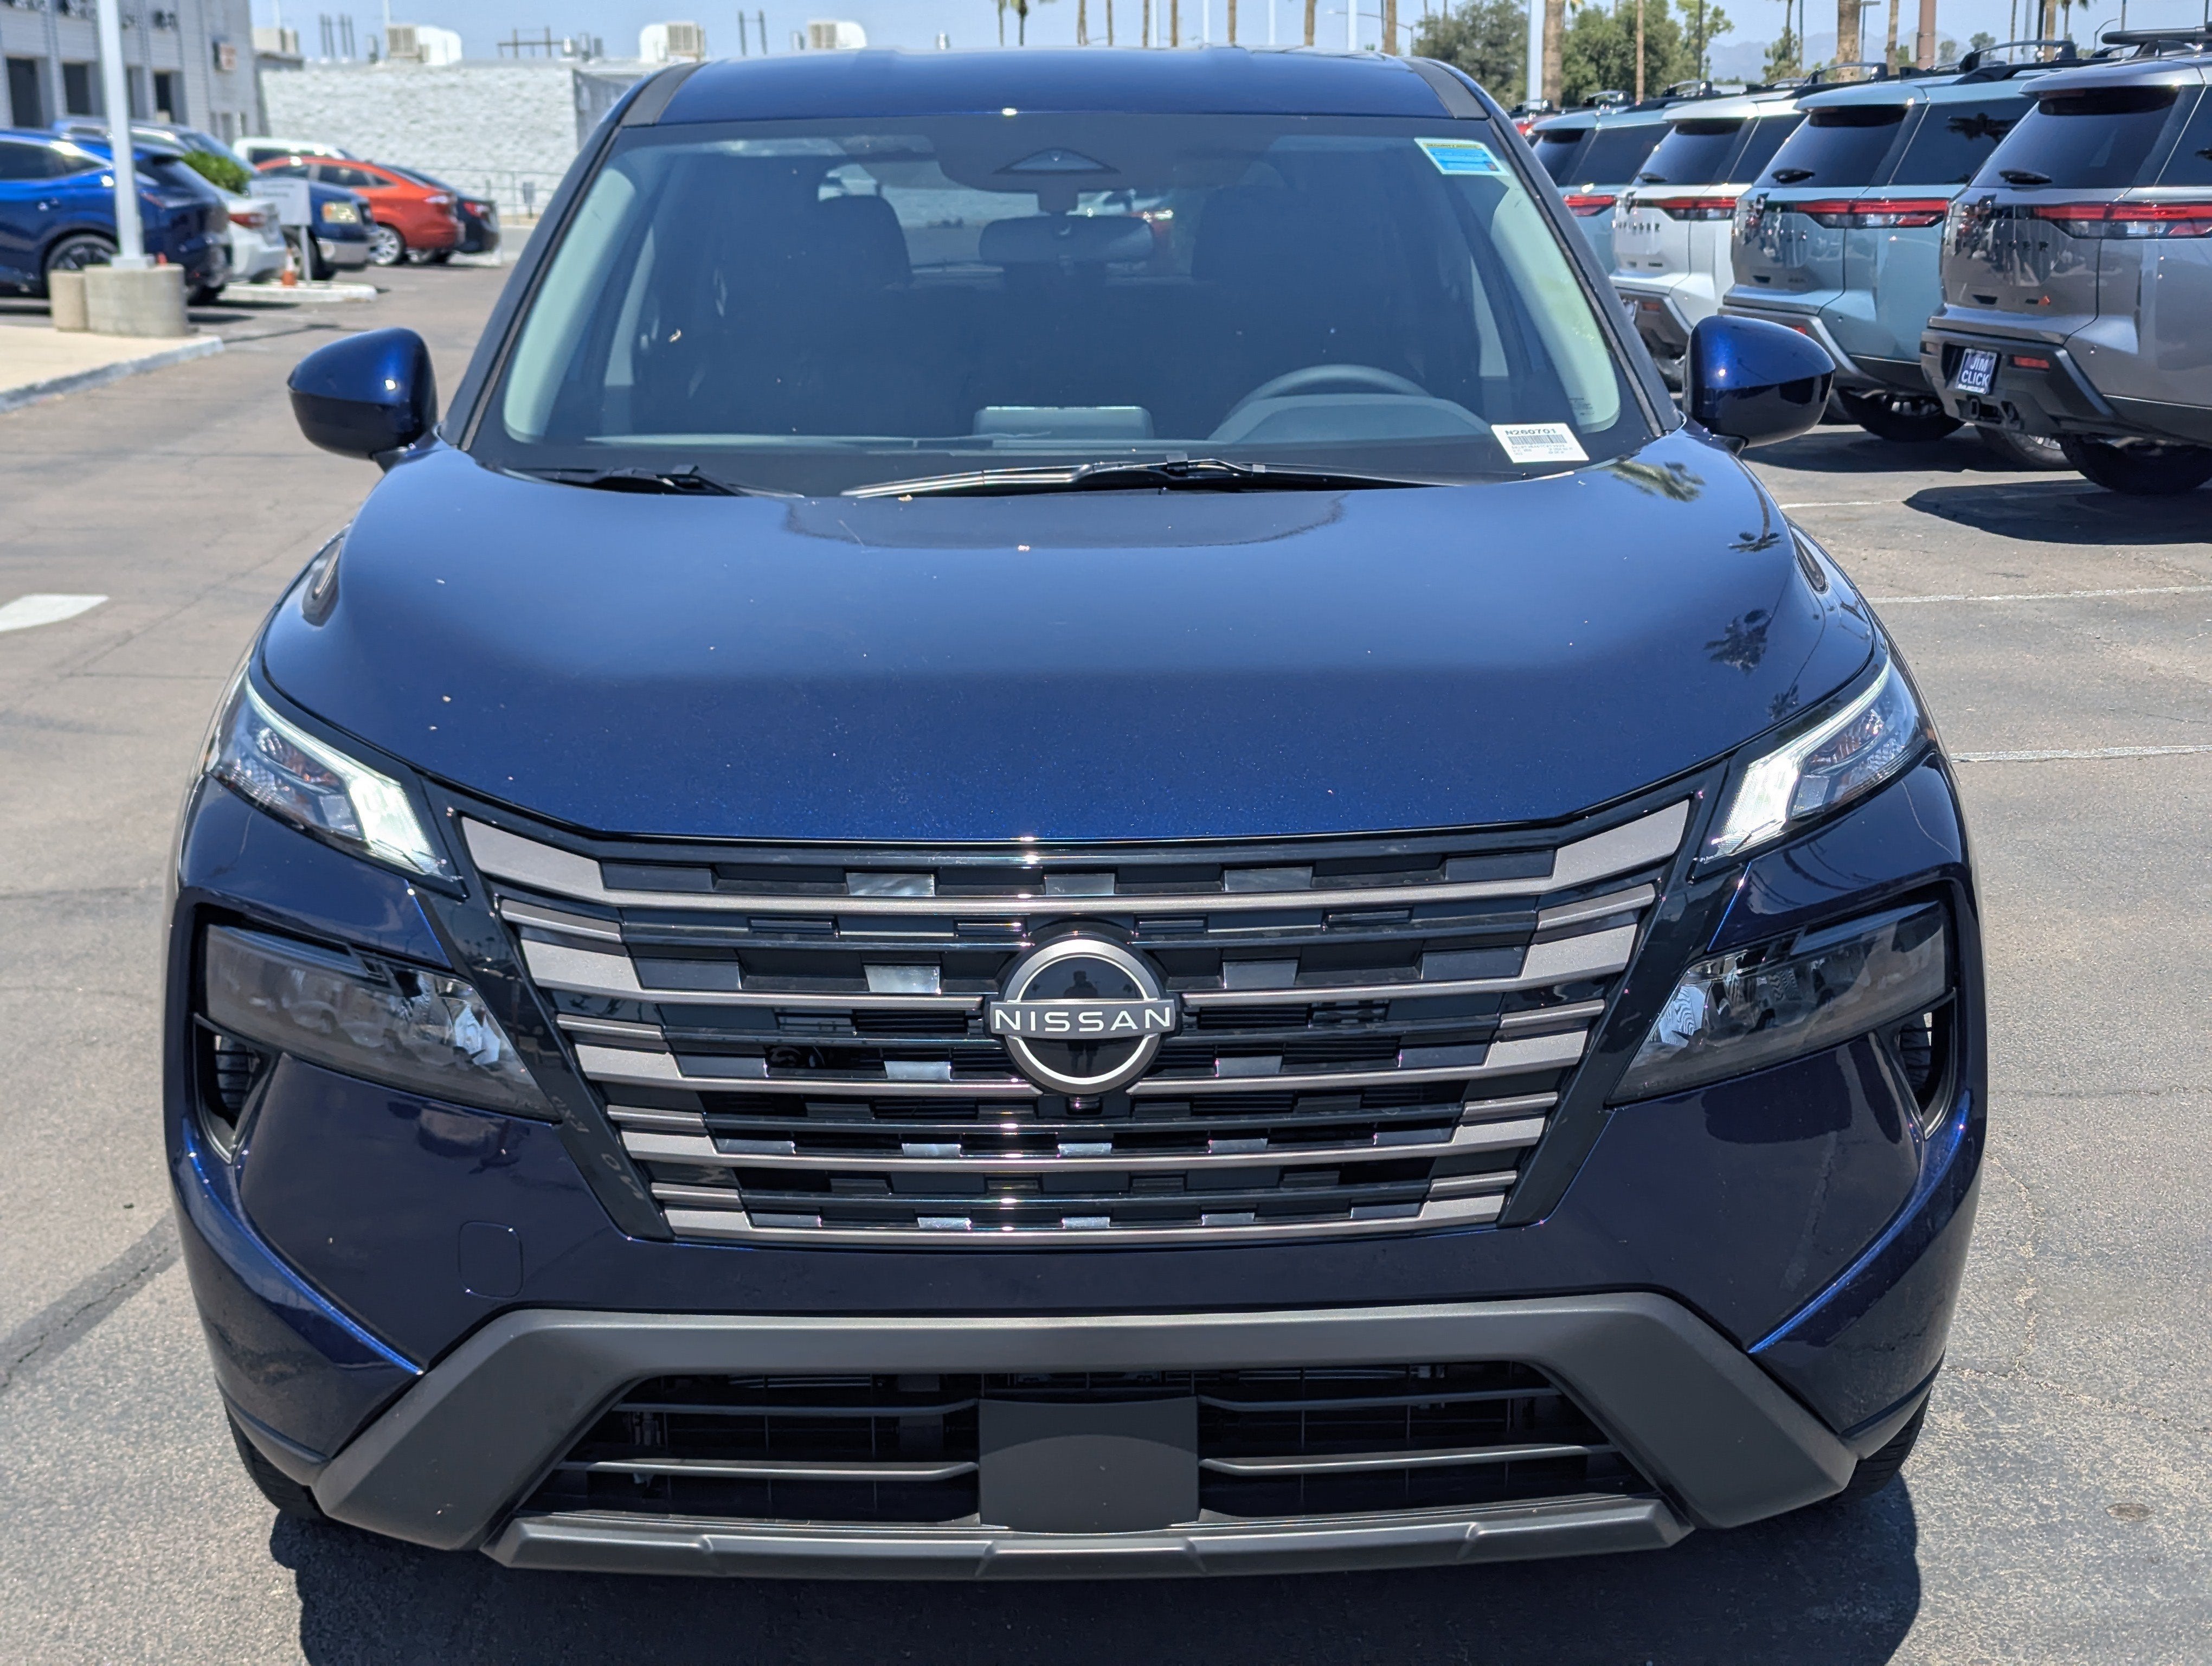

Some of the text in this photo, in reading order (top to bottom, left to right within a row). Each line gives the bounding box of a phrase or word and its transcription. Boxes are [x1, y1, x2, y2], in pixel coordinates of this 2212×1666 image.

[1970, 358, 1989, 371] JIM
[1962, 370, 1990, 387] CLICK
[995, 1007, 1170, 1032] NISSAN
